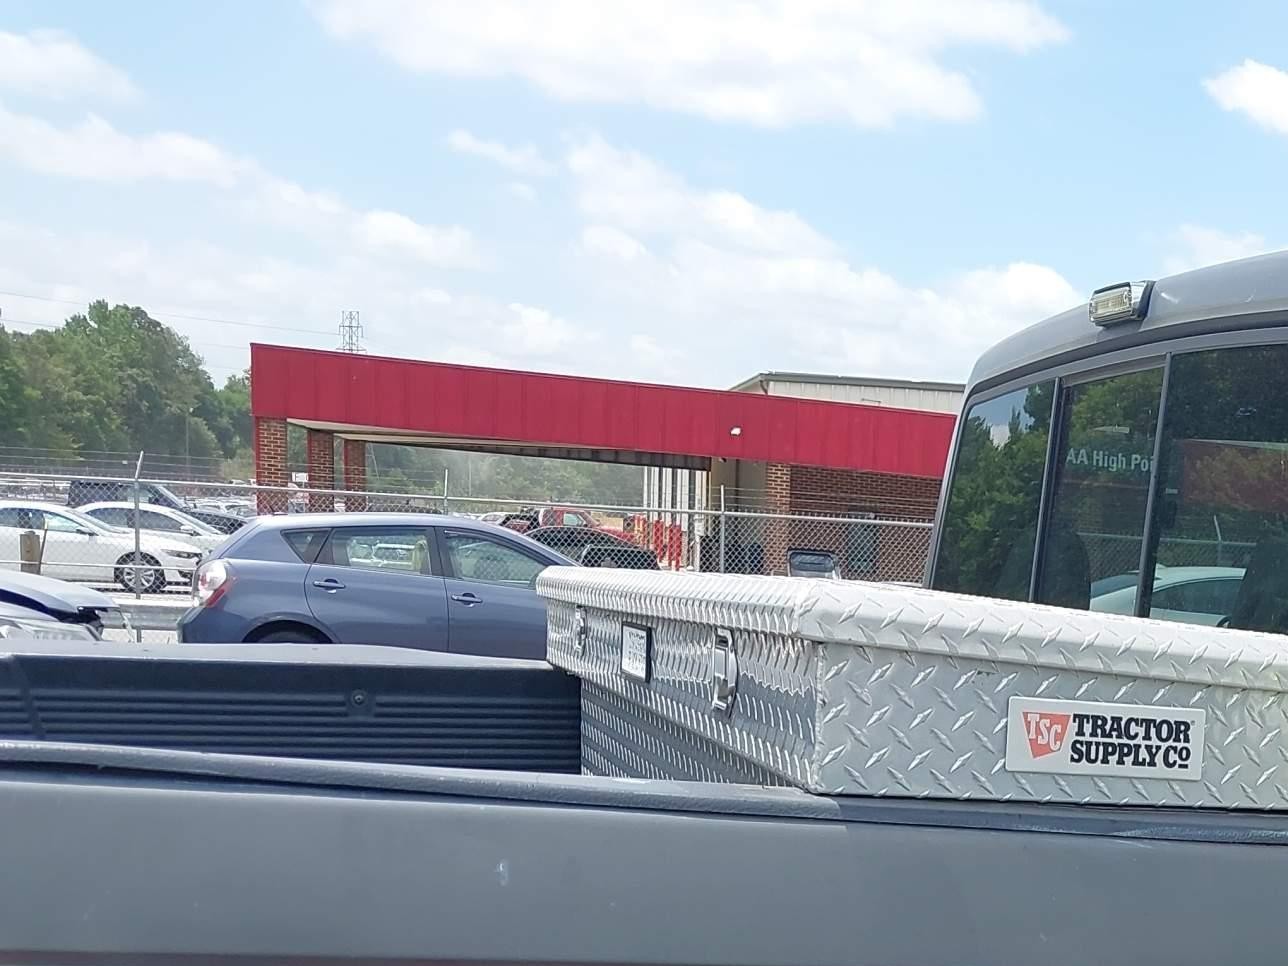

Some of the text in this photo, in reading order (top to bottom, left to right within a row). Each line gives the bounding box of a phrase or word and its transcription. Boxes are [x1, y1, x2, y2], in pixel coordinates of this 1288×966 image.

[1093, 450, 1126, 472] High
[1026, 713, 1062, 752] TSC
[1072, 713, 1191, 744] TRACTOR
[1070, 740, 1162, 768] SUPPLY
